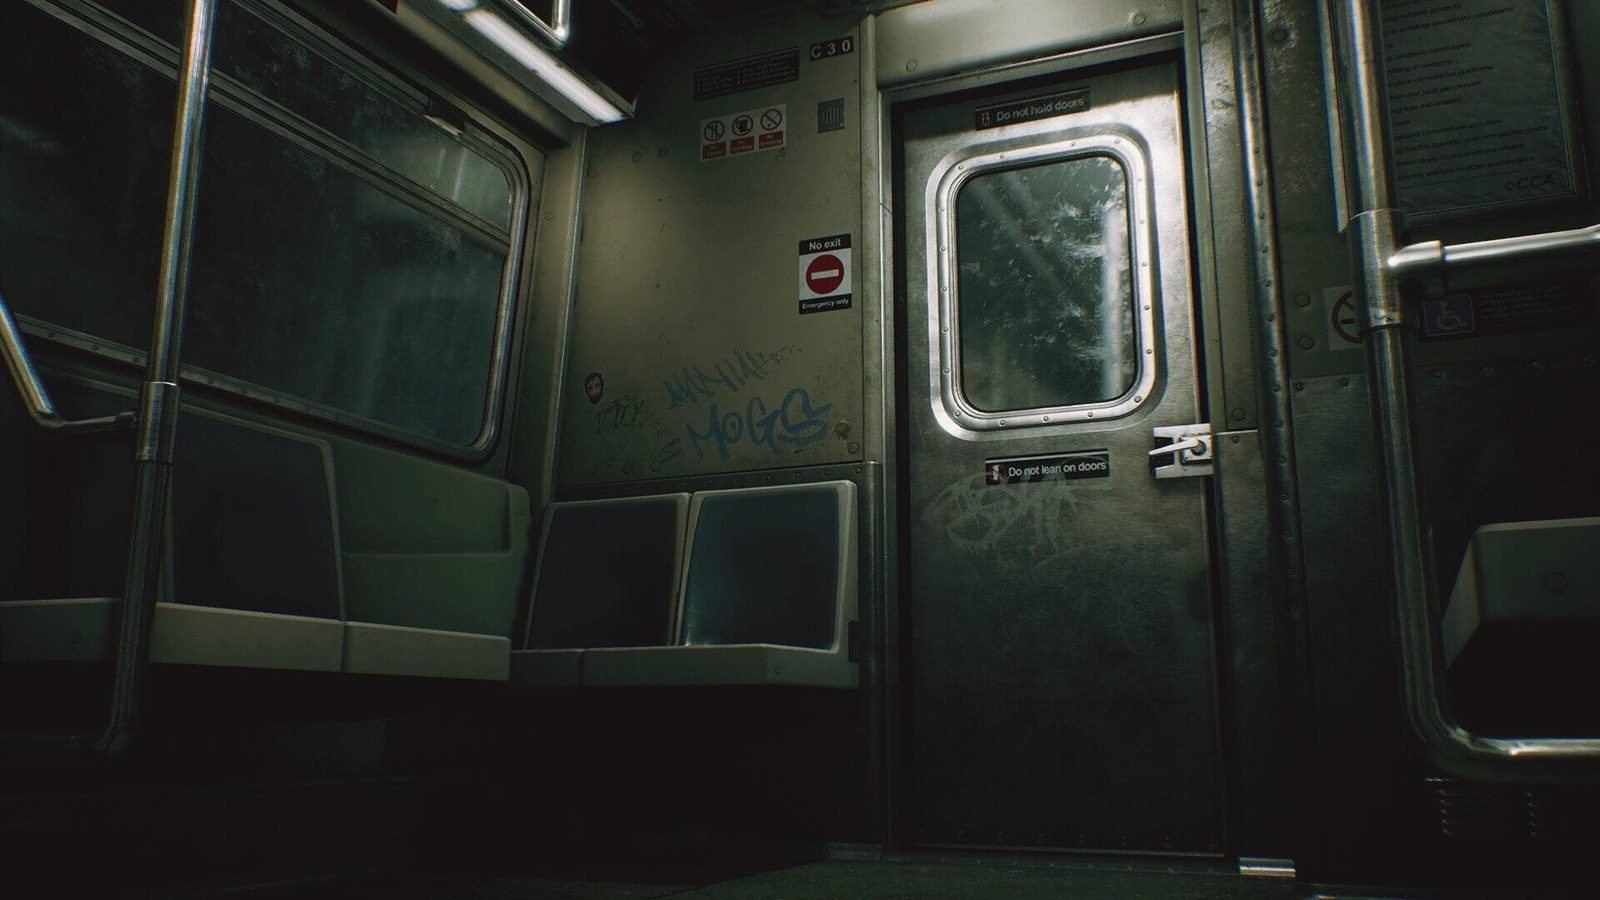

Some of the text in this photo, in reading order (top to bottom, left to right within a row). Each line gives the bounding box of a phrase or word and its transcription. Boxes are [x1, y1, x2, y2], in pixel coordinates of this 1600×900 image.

[996, 98, 1084, 122] Do not hold doors
[809, 237, 842, 250] No exit
[802, 297, 849, 310] Emergency only
[1008, 461, 1107, 477] Do not lean on doors
